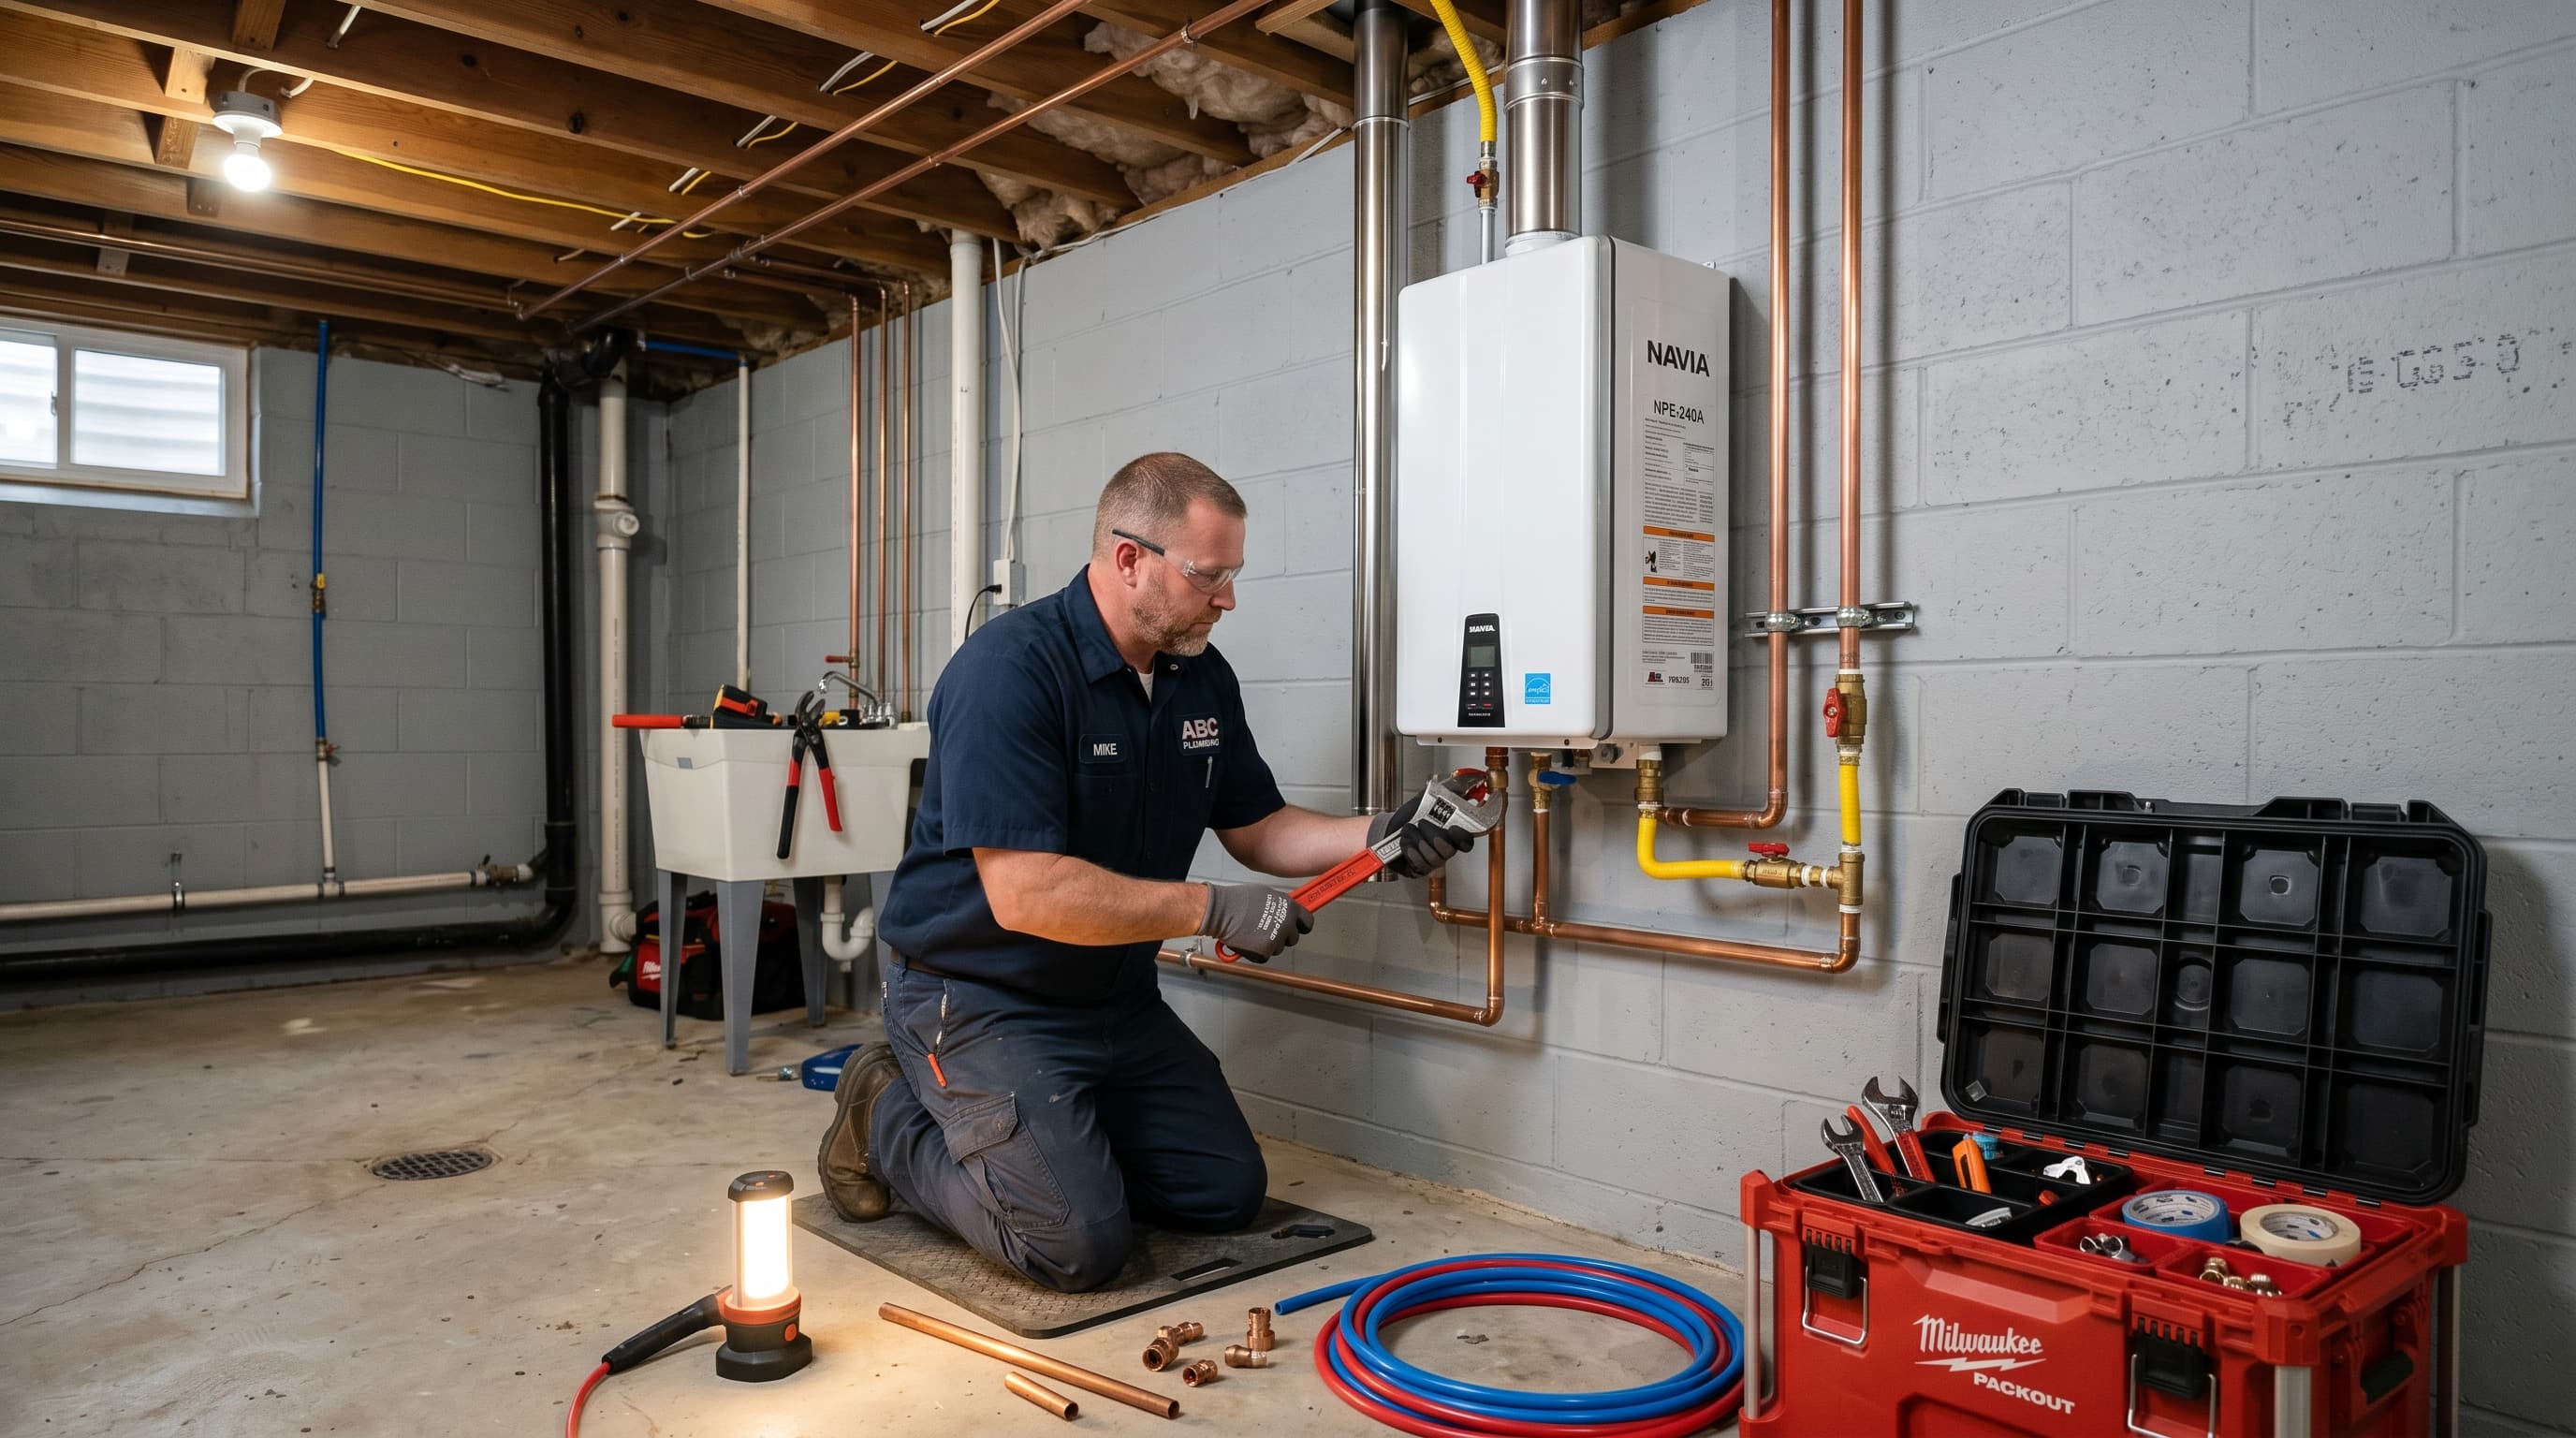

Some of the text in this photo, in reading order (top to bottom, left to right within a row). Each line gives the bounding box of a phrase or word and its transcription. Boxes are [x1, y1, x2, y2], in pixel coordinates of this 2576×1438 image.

[1647, 340, 1709, 376] NAVIA
[1182, 717, 1219, 740] ABC
[1093, 743, 1118, 756] MIKE
[1912, 1313, 2044, 1355] Milwaukee
[1973, 1372, 2075, 1415] PACKOUT
